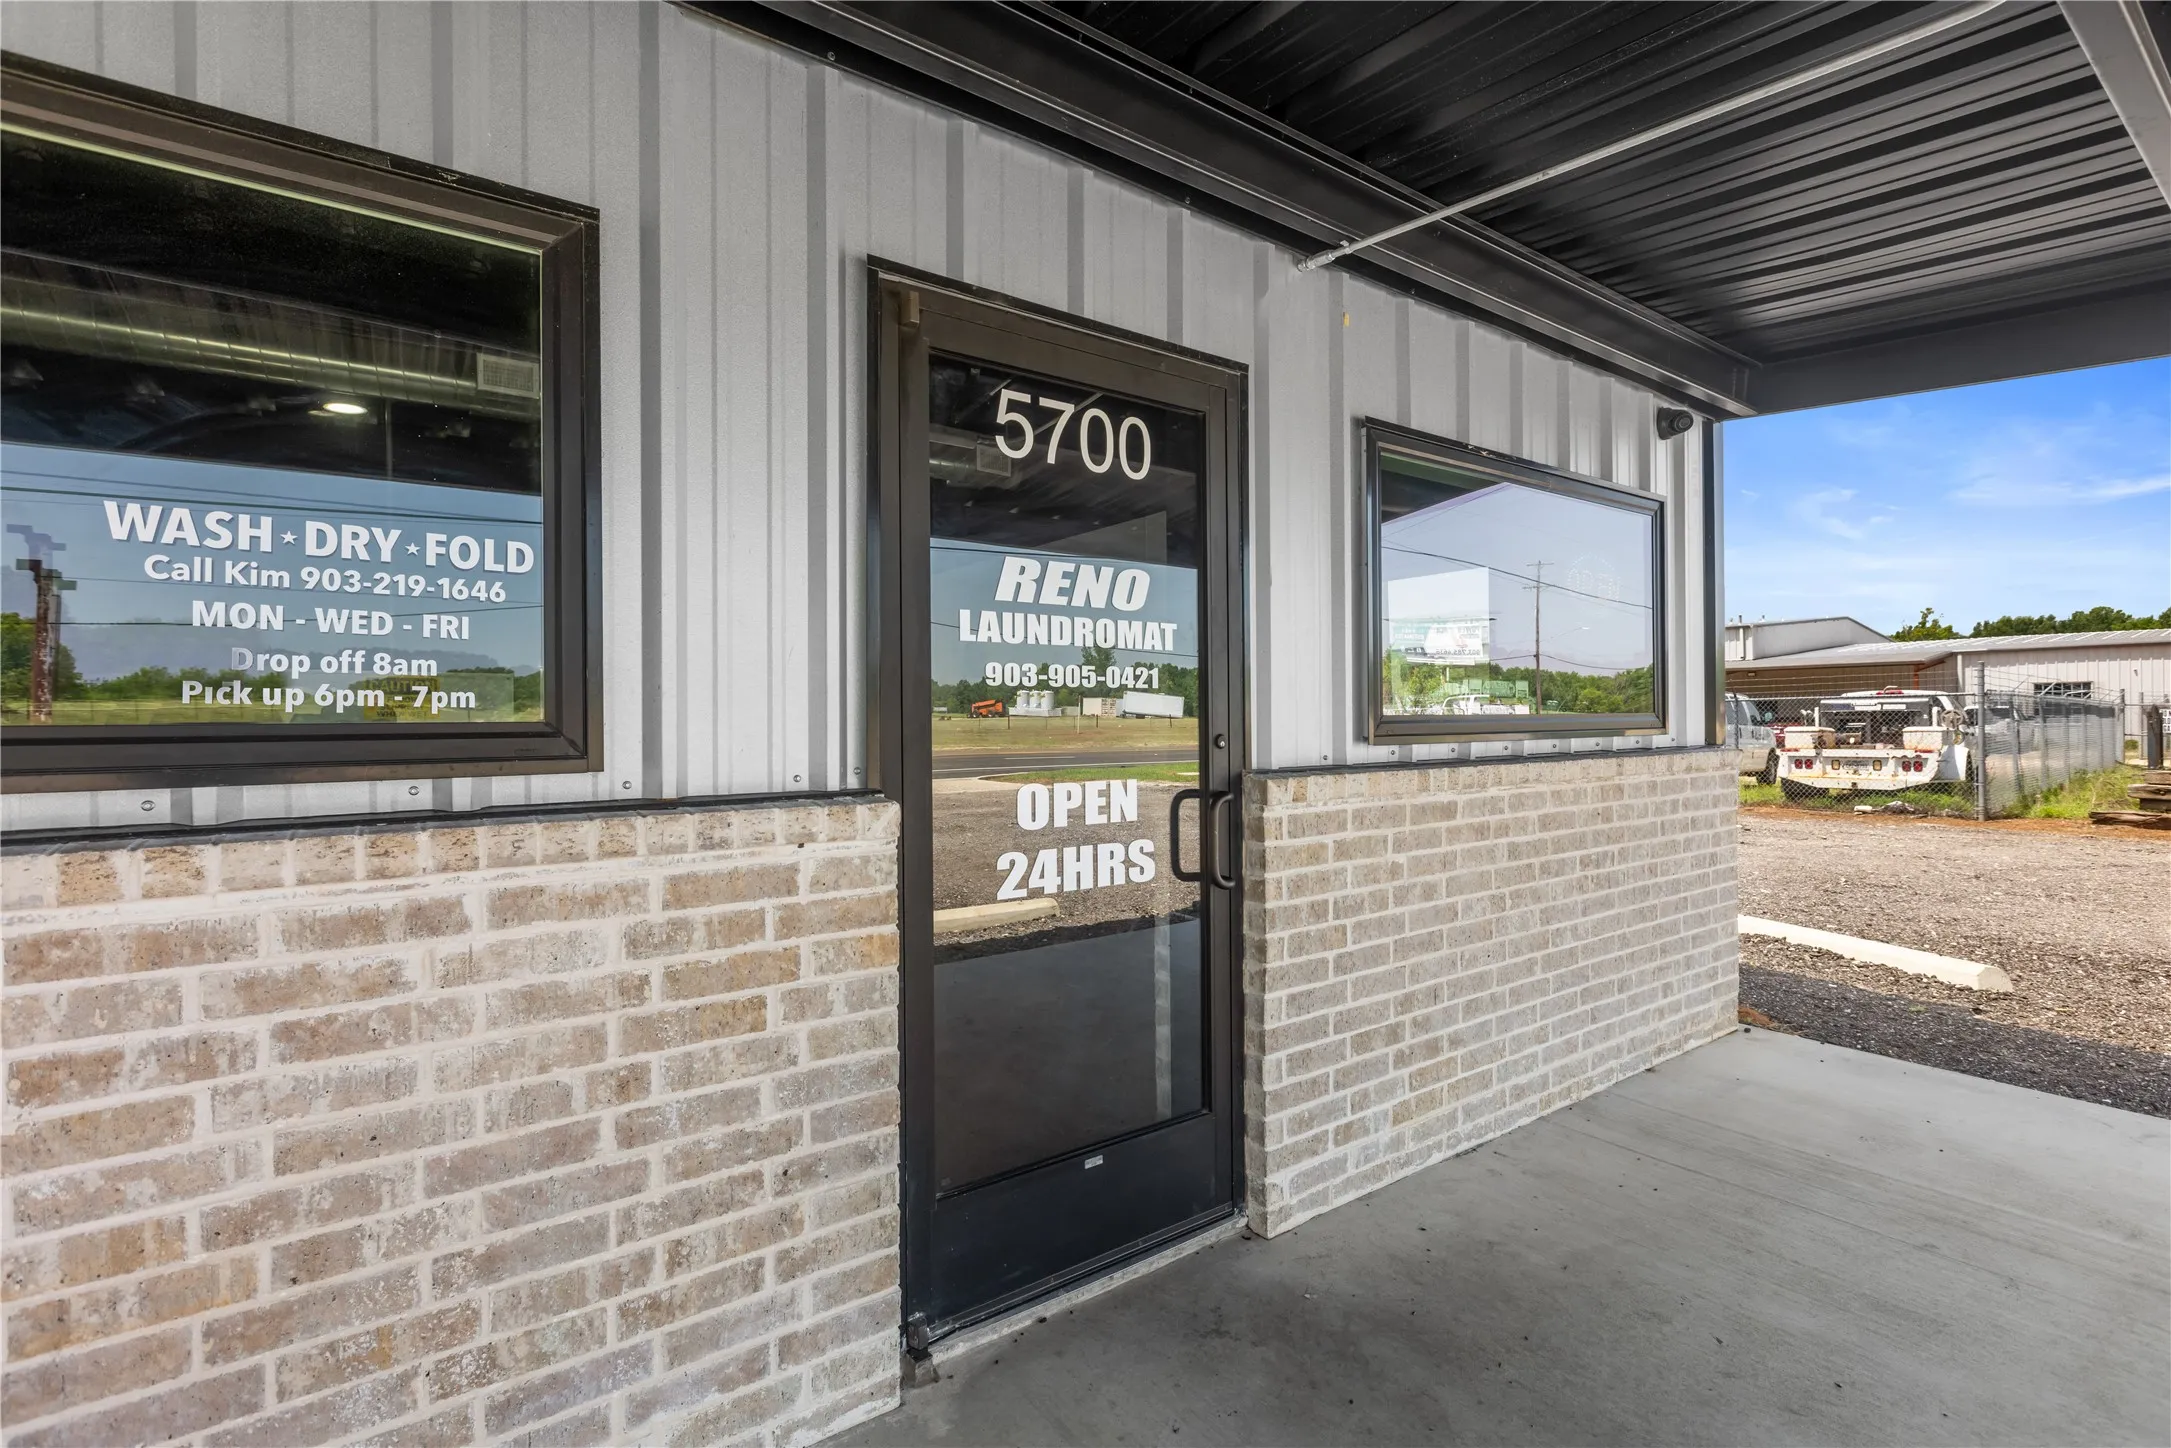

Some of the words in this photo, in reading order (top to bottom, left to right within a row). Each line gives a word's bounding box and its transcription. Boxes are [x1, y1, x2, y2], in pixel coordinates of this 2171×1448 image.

[995, 389, 1151, 480] 5700
[103, 500, 272, 552] WASH
[305, 521, 402, 562] DRY
[426, 534, 534, 573] FOLD
[144, 555, 212, 583] Call
[224, 561, 290, 588] Kim
[301, 567, 506, 603] 903-219-1646
[995, 556, 1151, 611] RENO
[192, 601, 284, 630] MON
[314, 608, 394, 636] WED
[423, 614, 470, 640] FRI
[959, 609, 1178, 651] LAUNDROMAT
[232, 647, 310, 678] Drop
[320, 650, 365, 675] off
[373, 653, 437, 676] 8am
[985, 662, 1160, 690] 903-905-0421
[182, 681, 252, 705] Pick
[263, 687, 304, 713] up
[314, 684, 384, 714] 6pm
[412, 686, 475, 715] 7pm
[1017, 780, 1138, 831] OPEN
[996, 839, 1156, 901] 24HRS
